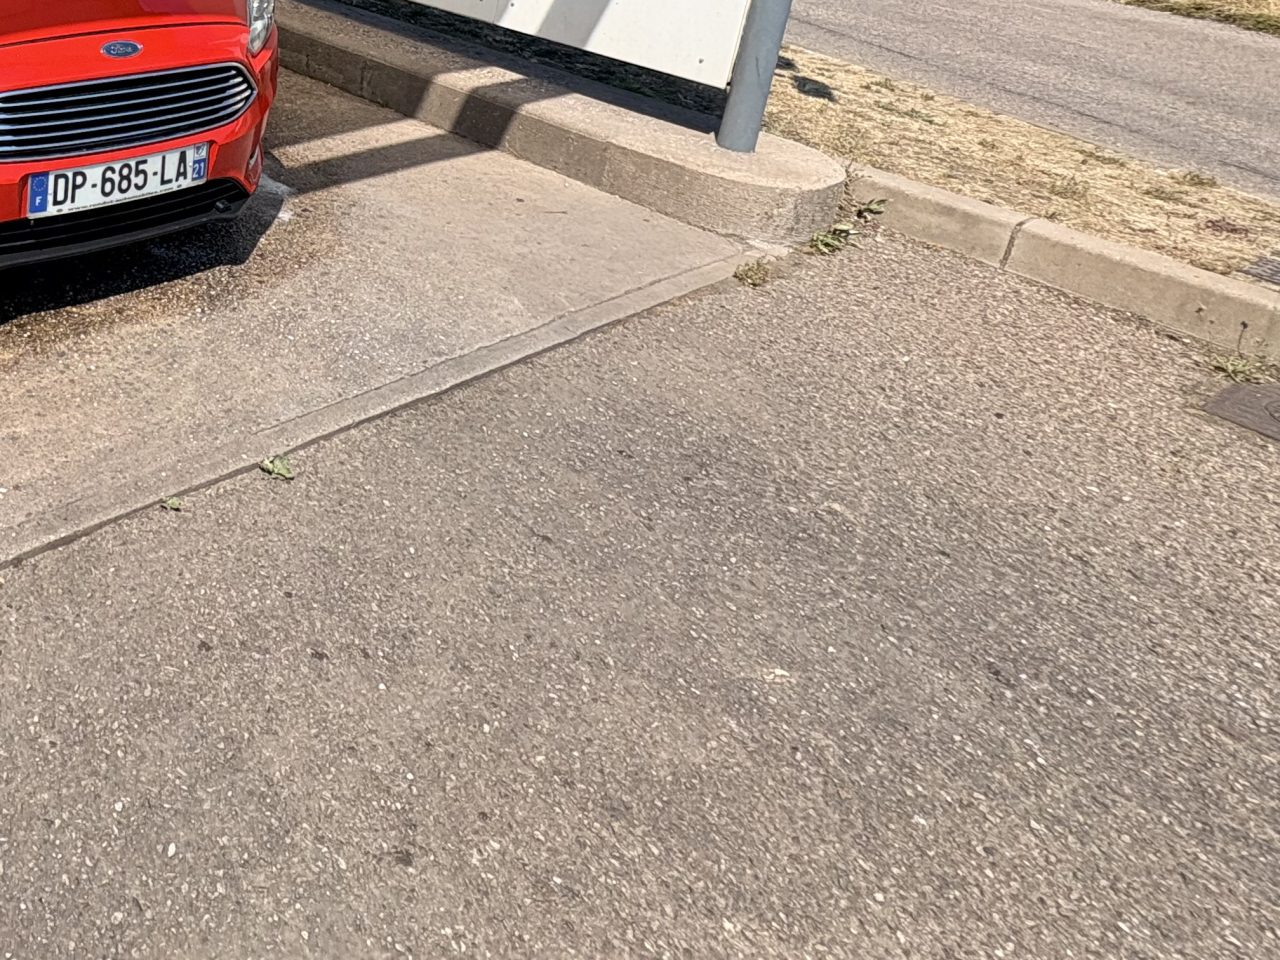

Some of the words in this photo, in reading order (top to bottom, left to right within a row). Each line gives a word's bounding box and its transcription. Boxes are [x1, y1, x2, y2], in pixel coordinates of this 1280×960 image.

[52, 150, 188, 207] DP-685-LA
[193, 163, 205, 177] 21
[35, 196, 42, 207] F
